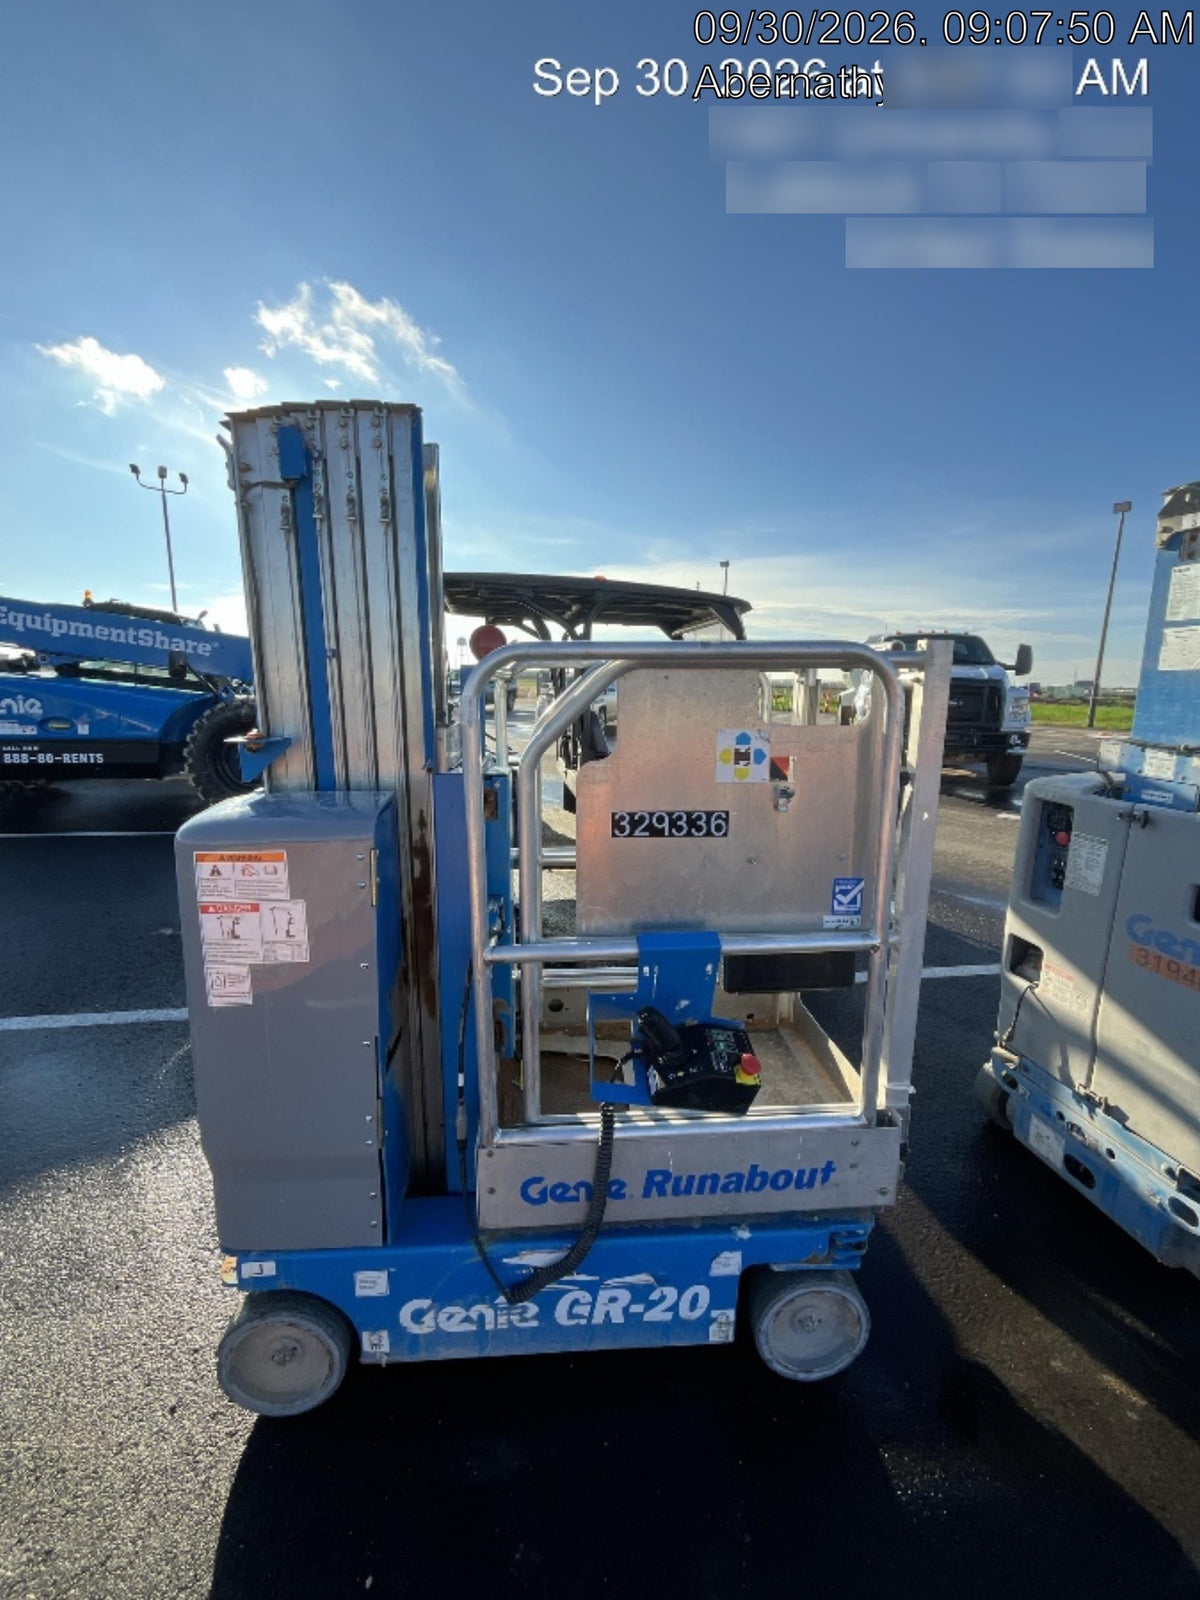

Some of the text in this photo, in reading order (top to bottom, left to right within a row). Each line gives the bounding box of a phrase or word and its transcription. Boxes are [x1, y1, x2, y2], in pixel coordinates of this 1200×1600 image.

[3, 753, 104, 764] 888-80-RENTS
[614, 811, 727, 837] 329336
[641, 1160, 836, 1199] Runabout
[555, 1285, 711, 1326] GR-20
